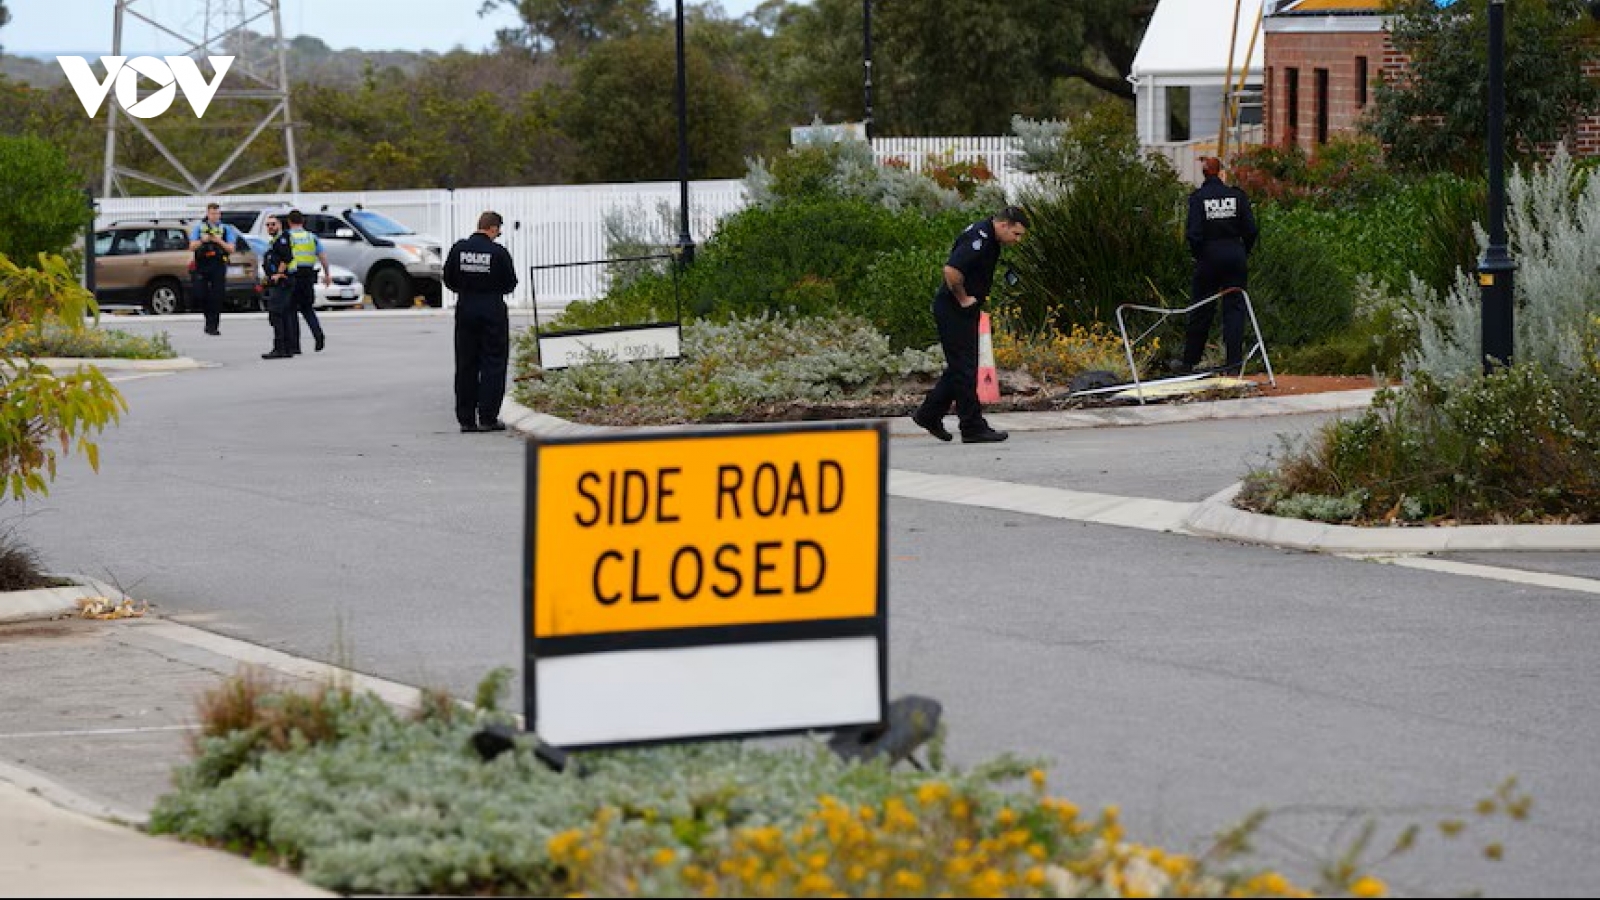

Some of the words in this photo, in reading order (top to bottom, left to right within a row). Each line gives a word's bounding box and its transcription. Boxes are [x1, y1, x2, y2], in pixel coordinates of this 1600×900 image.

[1203, 197, 1236, 211] POLICE
[459, 251, 491, 265] POLICE
[574, 467, 682, 528] SIDE
[716, 460, 845, 520] ROAD
[592, 540, 828, 606] CLOSED
